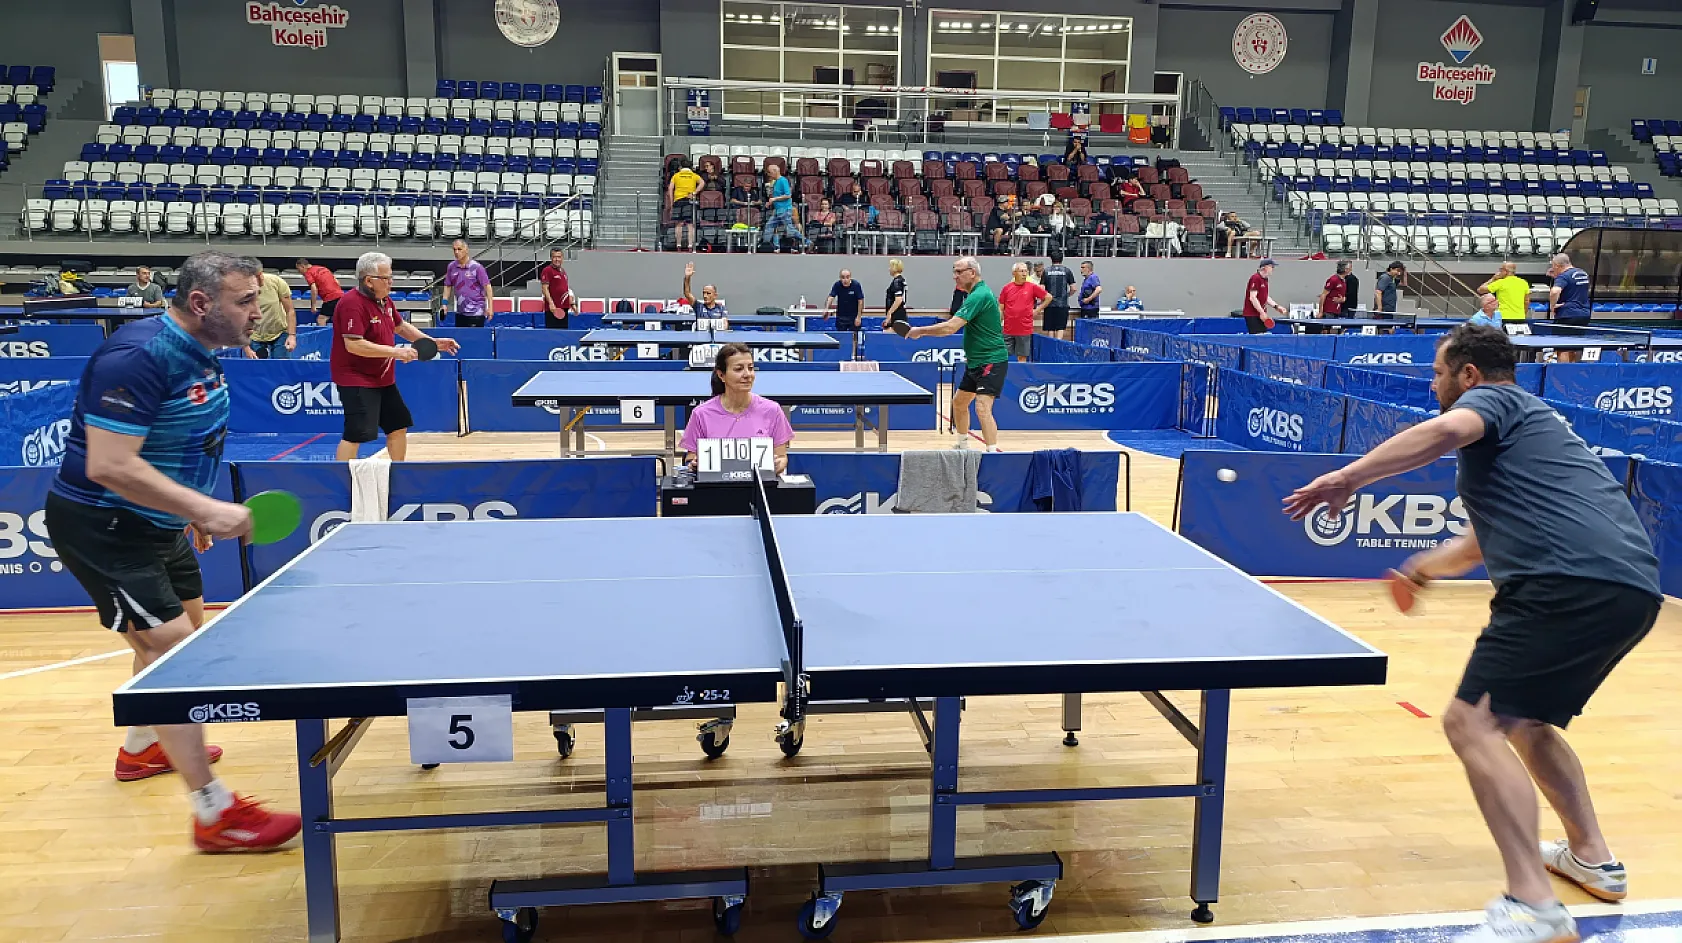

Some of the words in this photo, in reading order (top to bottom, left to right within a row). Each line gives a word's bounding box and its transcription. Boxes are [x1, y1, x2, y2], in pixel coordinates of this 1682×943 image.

[249, 5, 346, 26] Bahçeşehir
[274, 28, 324, 48] Koleji
[1419, 65, 1495, 83] Bahçeşehir
[1435, 85, 1474, 104] Koleji
[644, 347, 652, 356] 7
[931, 348, 967, 366] KB
[1047, 383, 1115, 407] KBS
[1618, 386, 1674, 410] KBS
[633, 406, 643, 419] 6
[801, 407, 820, 415] TABLE
[821, 407, 845, 415] TENNIS
[1262, 406, 1304, 442] KBS
[703, 446, 712, 471] 1
[755, 444, 769, 469] 7
[1356, 538, 1391, 548] TABLE
[1393, 538, 1438, 548] TENNIS
[703, 689, 730, 701] 25-2
[208, 702, 261, 718] KBS
[447, 714, 475, 750] 5
